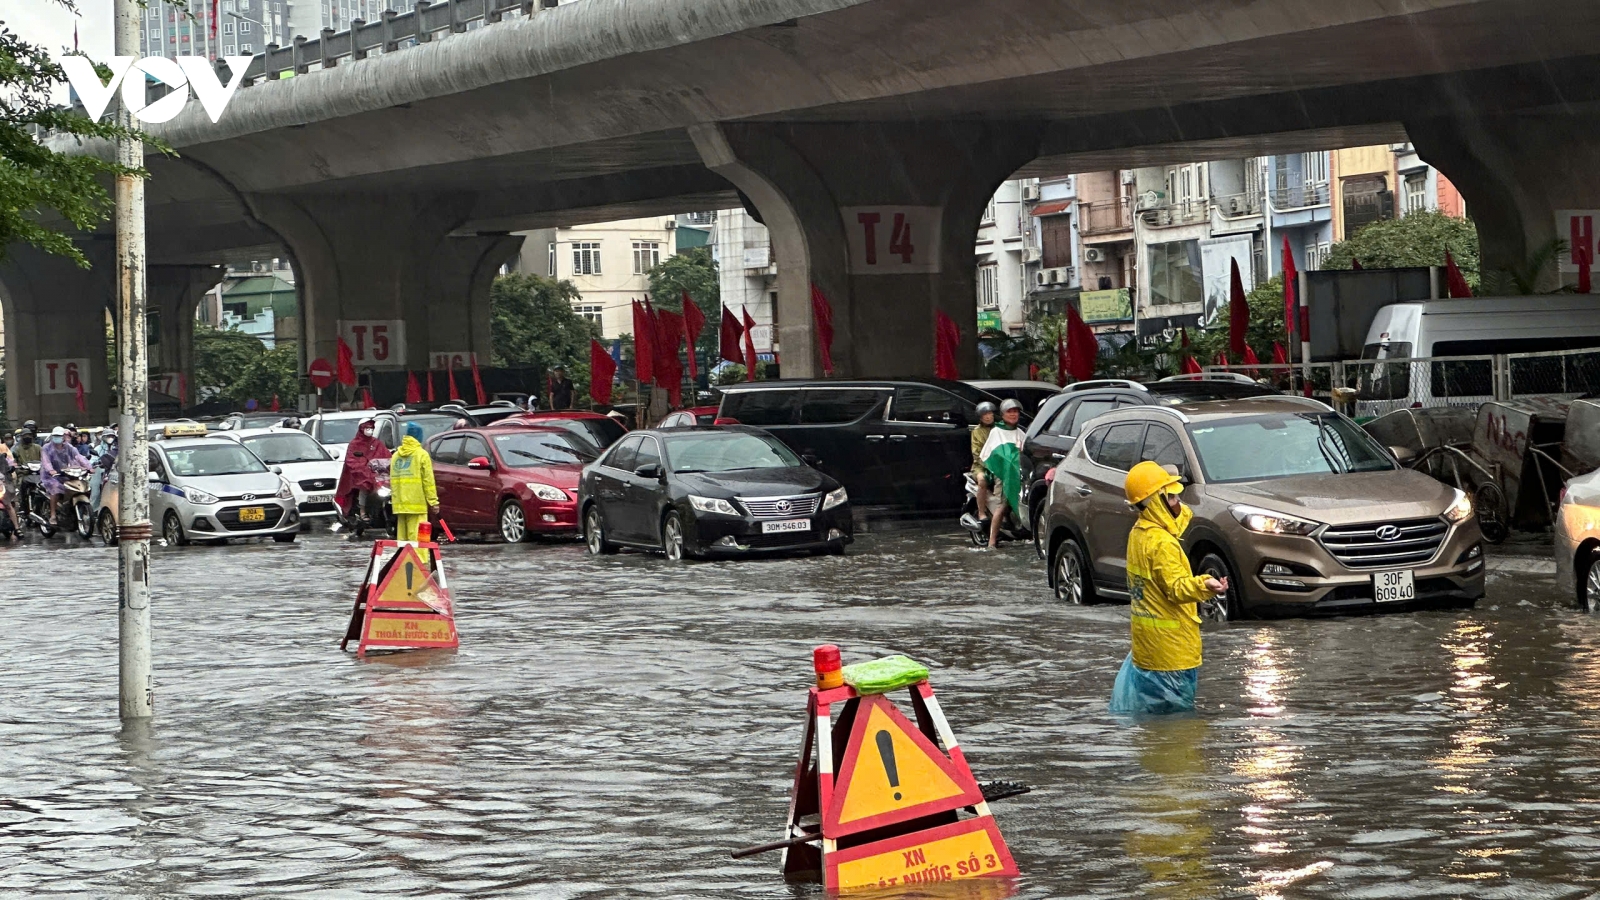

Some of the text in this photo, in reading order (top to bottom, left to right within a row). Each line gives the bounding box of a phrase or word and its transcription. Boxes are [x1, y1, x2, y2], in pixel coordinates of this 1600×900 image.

[1570, 215, 1600, 265] H
[767, 522, 807, 531] 30M-546.03
[1383, 572, 1404, 586] 30F
[1377, 585, 1413, 601] 609.40
[902, 848, 926, 868] XN
[956, 852, 981, 876] SỐ
[984, 854, 996, 868] 3
